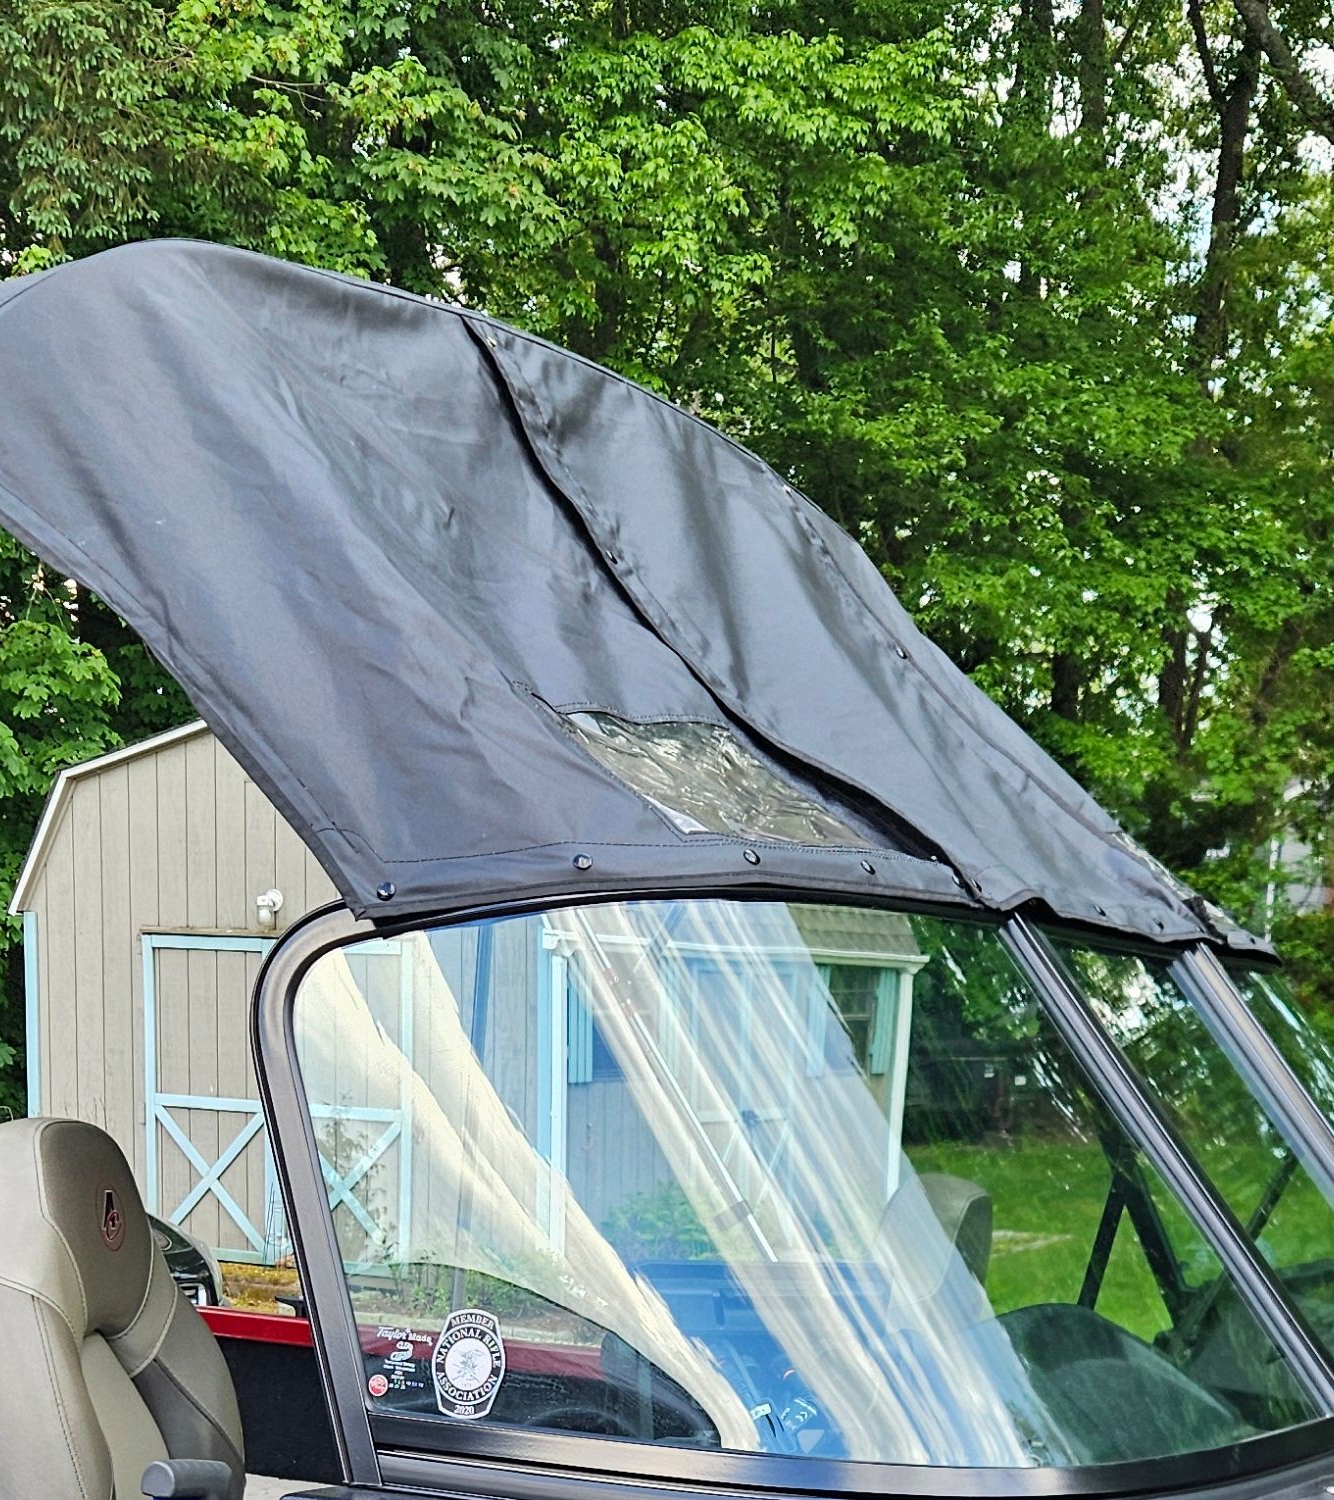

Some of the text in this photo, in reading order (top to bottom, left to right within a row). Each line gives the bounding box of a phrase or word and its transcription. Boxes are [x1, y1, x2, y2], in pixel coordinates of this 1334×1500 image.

[451, 1313, 495, 1330] MEMBER
[437, 1327, 502, 1401] NATIONAL RIFLE ASSOCIATION
[453, 1404, 475, 1416] 2020
